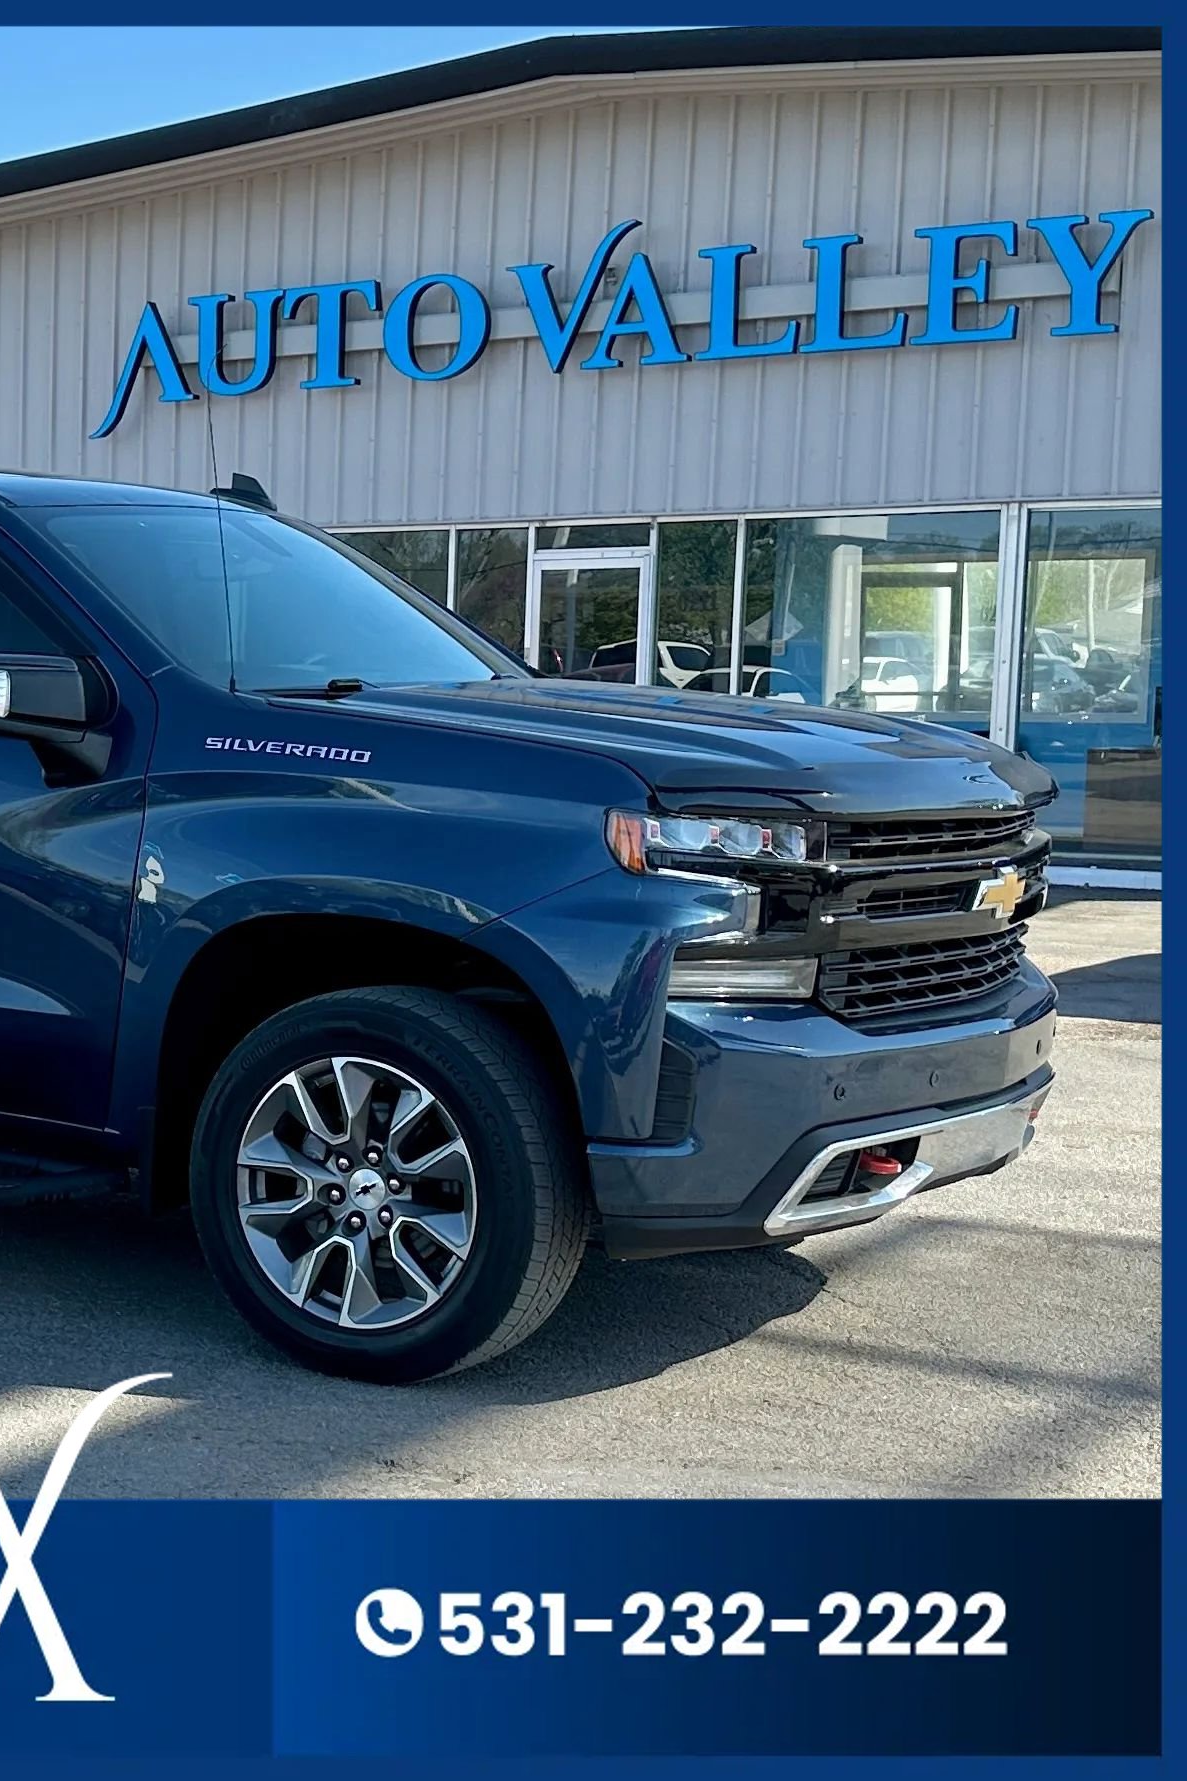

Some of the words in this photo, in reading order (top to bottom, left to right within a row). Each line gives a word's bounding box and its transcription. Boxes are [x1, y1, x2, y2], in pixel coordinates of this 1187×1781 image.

[90, 272, 492, 439] AUTO
[505, 208, 1153, 376] VALLEY
[204, 736, 372, 764] SILVERADO
